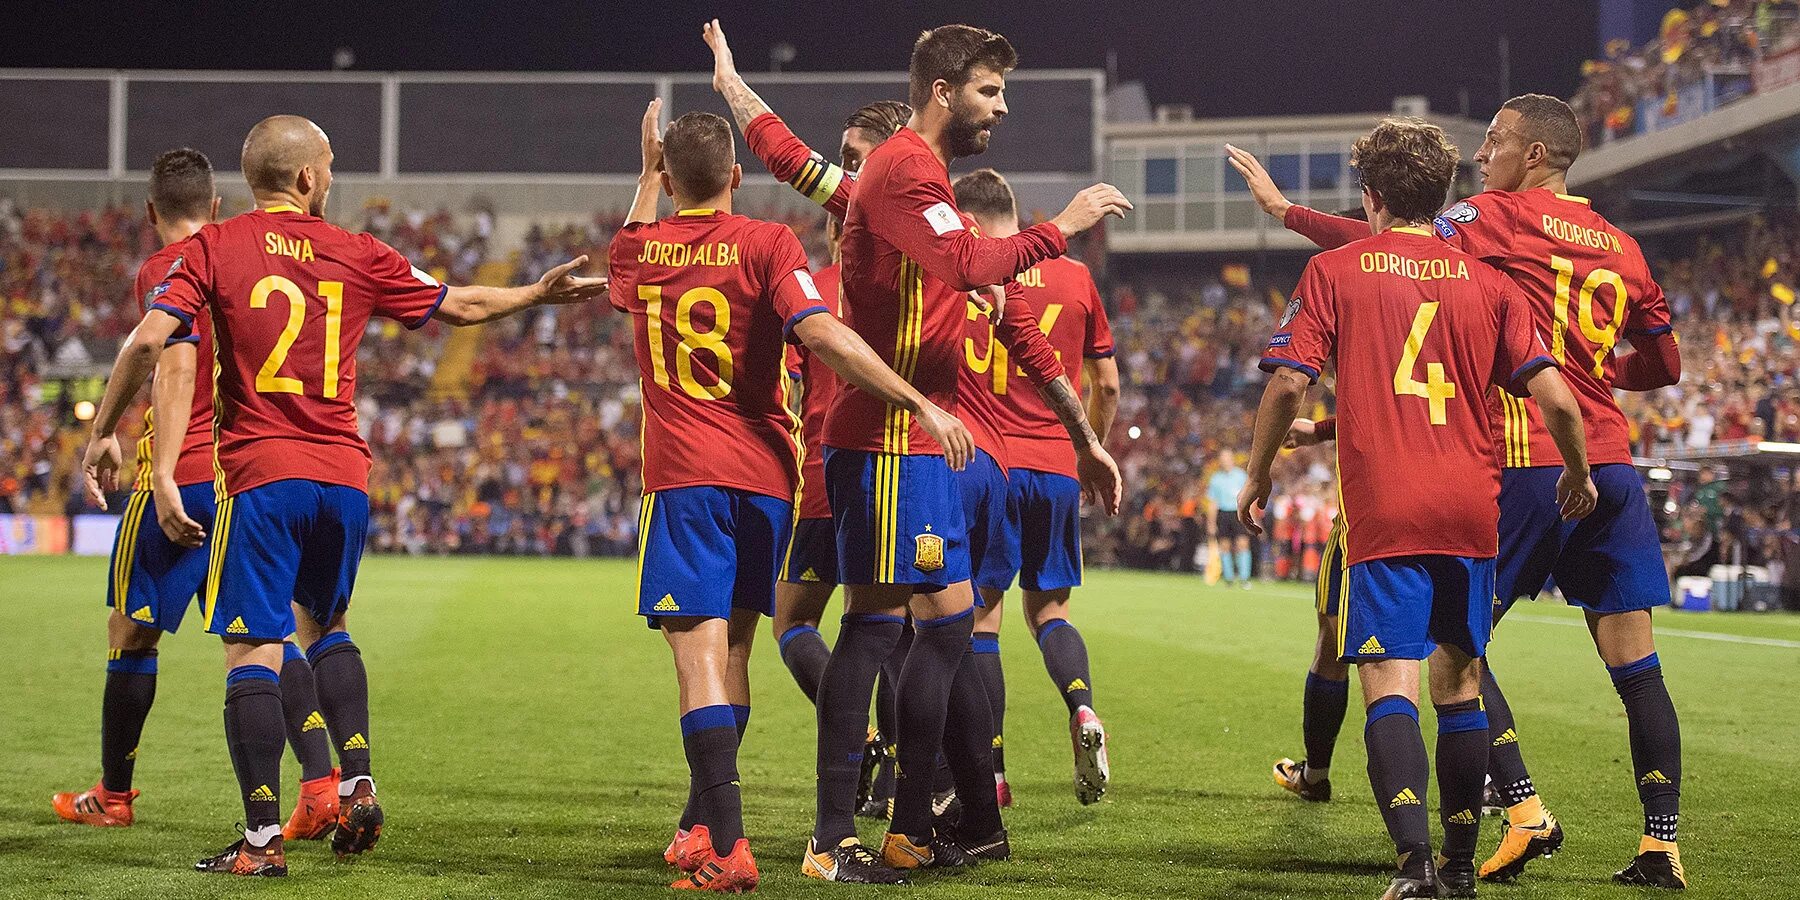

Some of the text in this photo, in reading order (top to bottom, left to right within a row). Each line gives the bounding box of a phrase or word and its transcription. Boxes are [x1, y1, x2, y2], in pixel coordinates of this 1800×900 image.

[265, 231, 315, 263] SILVA
[1542, 214, 1610, 251] RODRIGO
[637, 240, 739, 267] JORDI ALBA
[1360, 252, 1470, 281] ODRIOZOLA
[1551, 255, 1628, 379] 19
[250, 275, 344, 398] 21
[638, 285, 733, 400] 18
[1394, 301, 1455, 425] 4
[1492, 737, 1519, 746] adida
[1390, 800, 1421, 808] adidas
